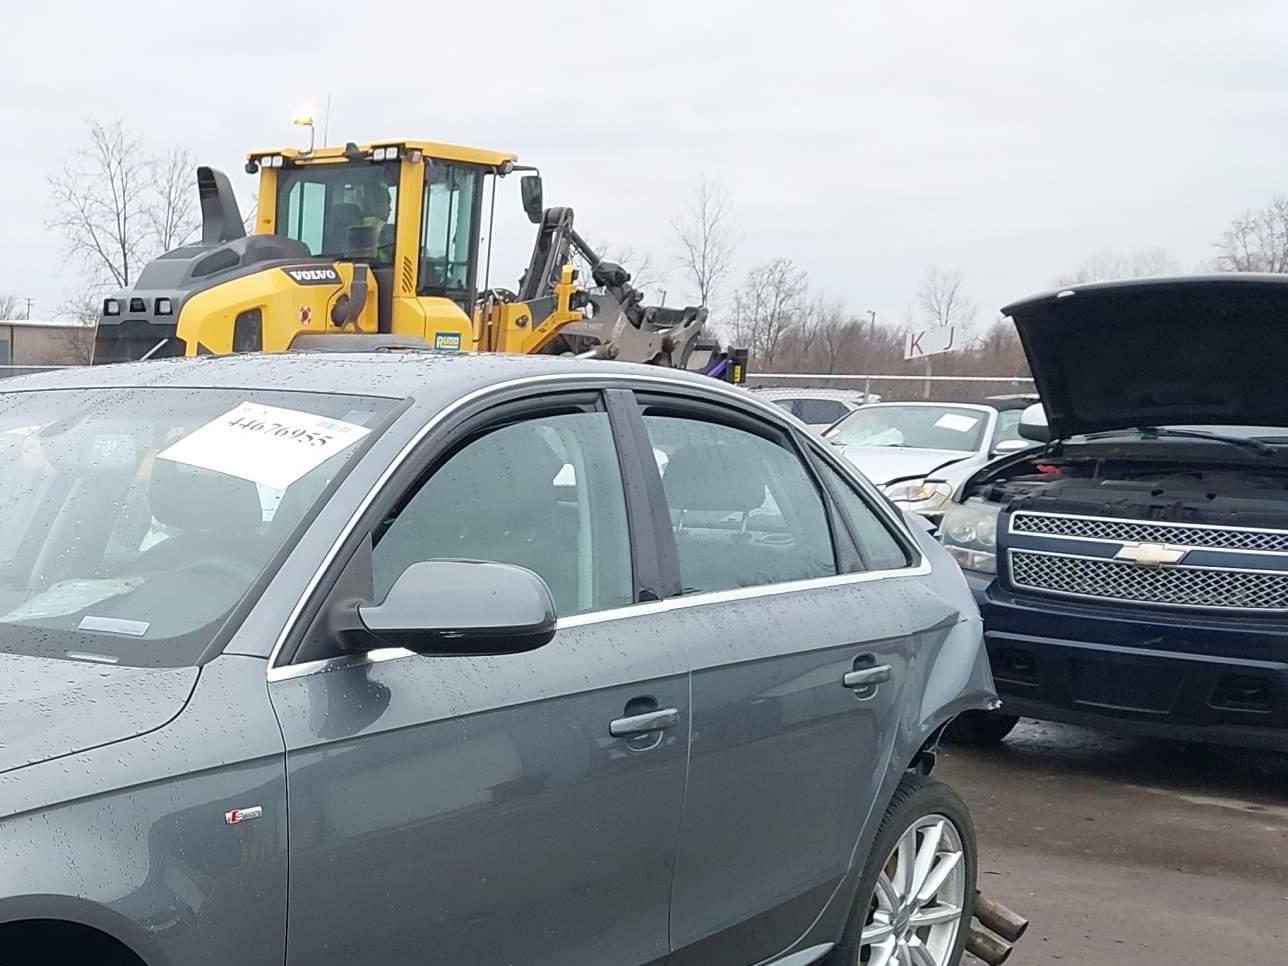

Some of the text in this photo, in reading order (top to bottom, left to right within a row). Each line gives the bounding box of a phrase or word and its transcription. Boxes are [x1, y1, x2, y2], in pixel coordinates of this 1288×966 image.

[289, 270, 336, 281] VOLVO
[909, 326, 955, 357] K J
[227, 417, 334, 447] 44676955
